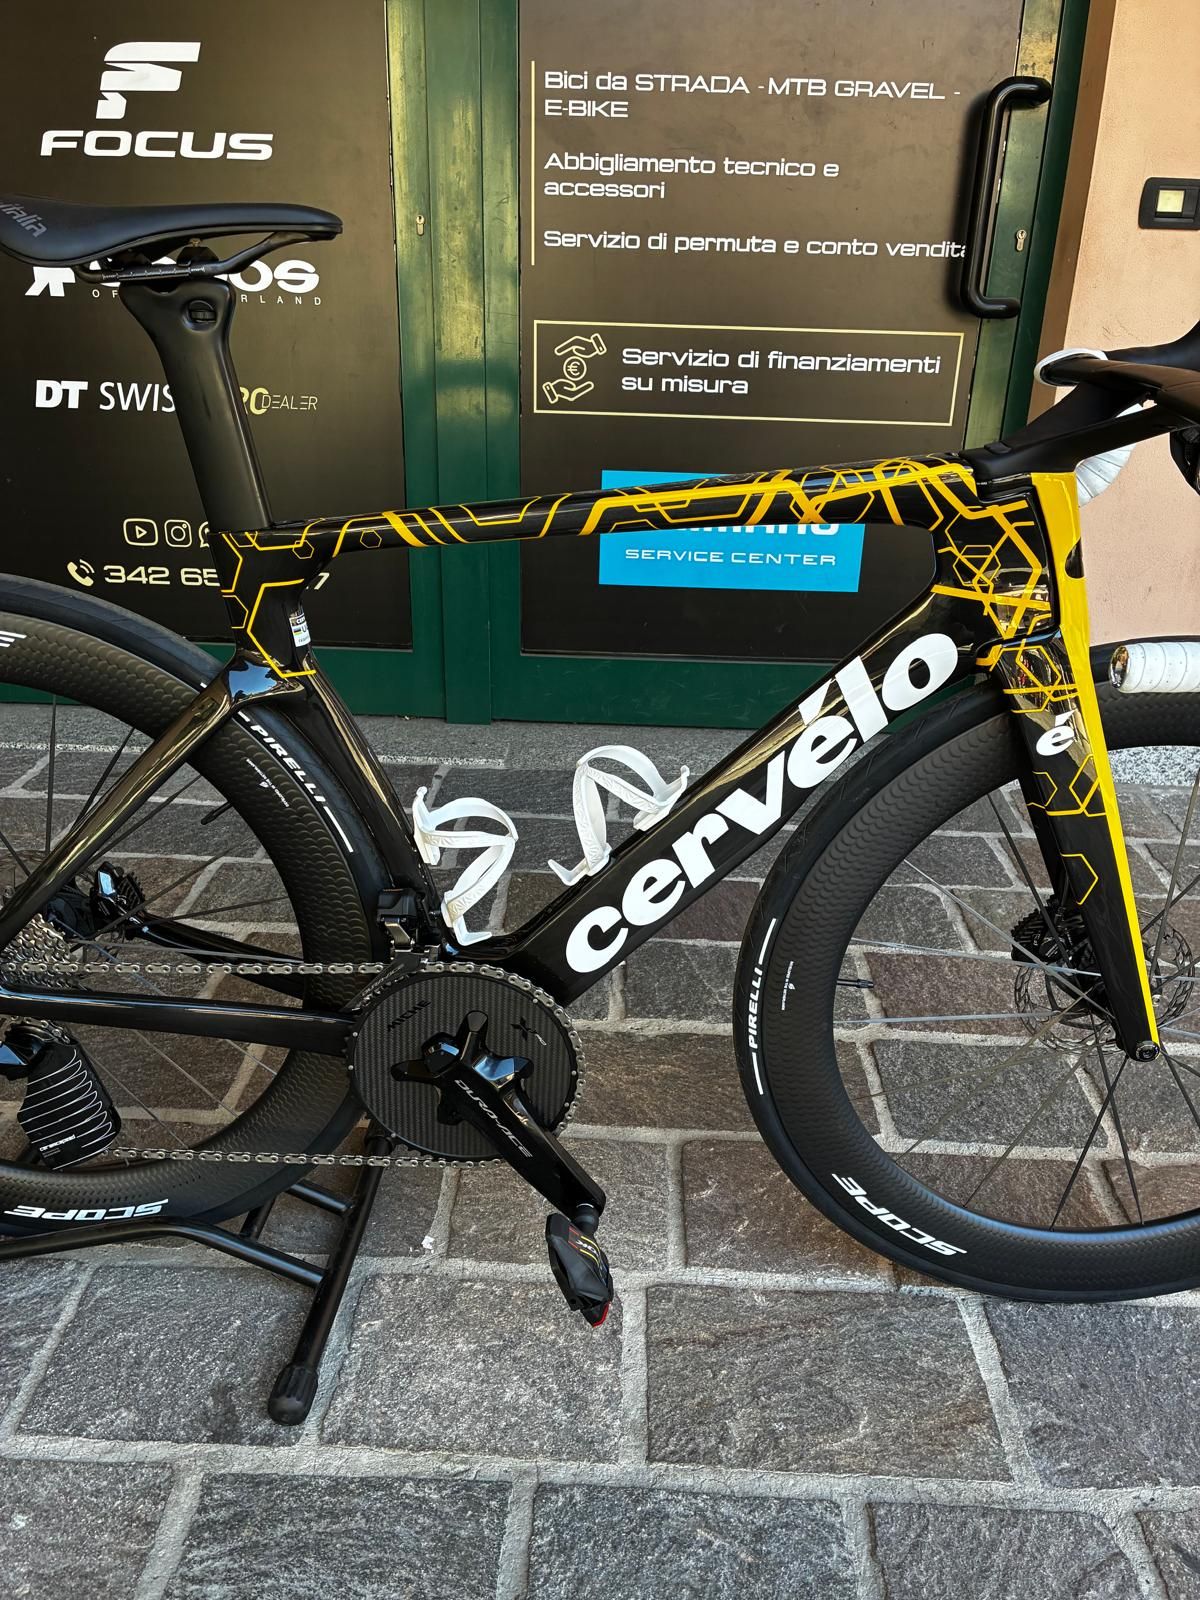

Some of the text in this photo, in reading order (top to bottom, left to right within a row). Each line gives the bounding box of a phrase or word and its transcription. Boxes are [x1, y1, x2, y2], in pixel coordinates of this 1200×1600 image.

[544, 70, 588, 90] Bici
[595, 71, 628, 91] da
[634, 73, 751, 94] STRADA
[834, 79, 946, 100] GRAVEL
[544, 99, 629, 118] E-BIKE
[40, 130, 274, 161] FOCUS
[544, 152, 840, 178] Abbigliamento tecnico e
[543, 181, 666, 199] accessori
[543, 231, 641, 249] Servizio
[647, 232, 668, 250] di
[674, 235, 777, 254] permuta
[783, 240, 800, 254] e
[806, 238, 879, 256] conto
[622, 348, 941, 374] Servizio di finanziamenti
[35, 379, 89, 409] DT
[621, 375, 749, 394] su misura
[624, 548, 837, 567] SERVICE CENTER
[103, 565, 171, 585] 342
[250, 724, 326, 803] PIRELLI
[565, 633, 960, 975] cervélo
[748, 966, 764, 1050] PIRELLI
[454, 1079, 533, 1158] DURA-ACE
[4, 1198, 169, 1221] SCOPE
[831, 1173, 968, 1257] SCOPE
